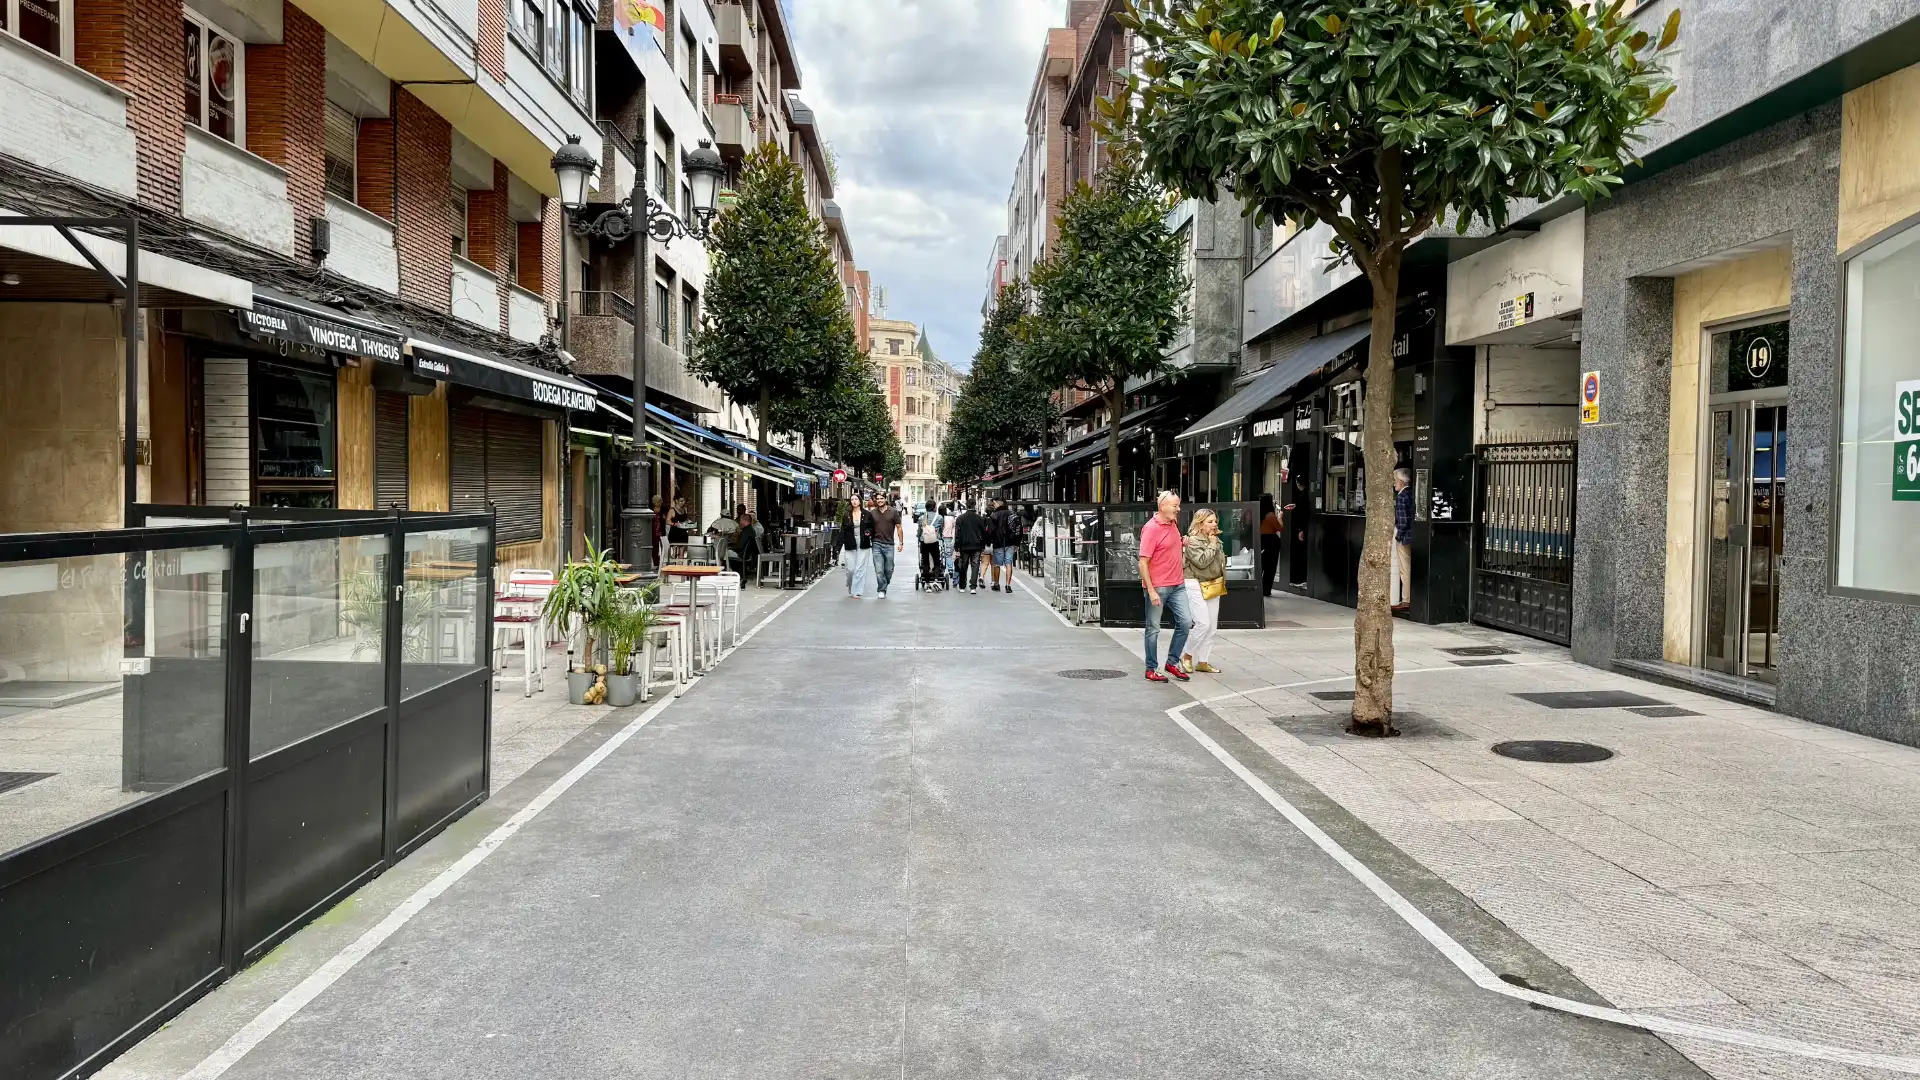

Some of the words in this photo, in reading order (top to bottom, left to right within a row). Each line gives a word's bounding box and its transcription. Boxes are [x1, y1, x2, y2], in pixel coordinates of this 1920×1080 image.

[246, 311, 288, 331] VICTORIA
[309, 325, 357, 352] VINOTECA
[361, 339, 399, 361] THYRSUS
[1391, 333, 1409, 358] tail
[1751, 347, 1768, 369] 19
[533, 380, 561, 406] BODEGA
[562, 388, 571, 407] DE
[571, 391, 596, 412] AVELINO
[133, 556, 180, 580] Coktail
